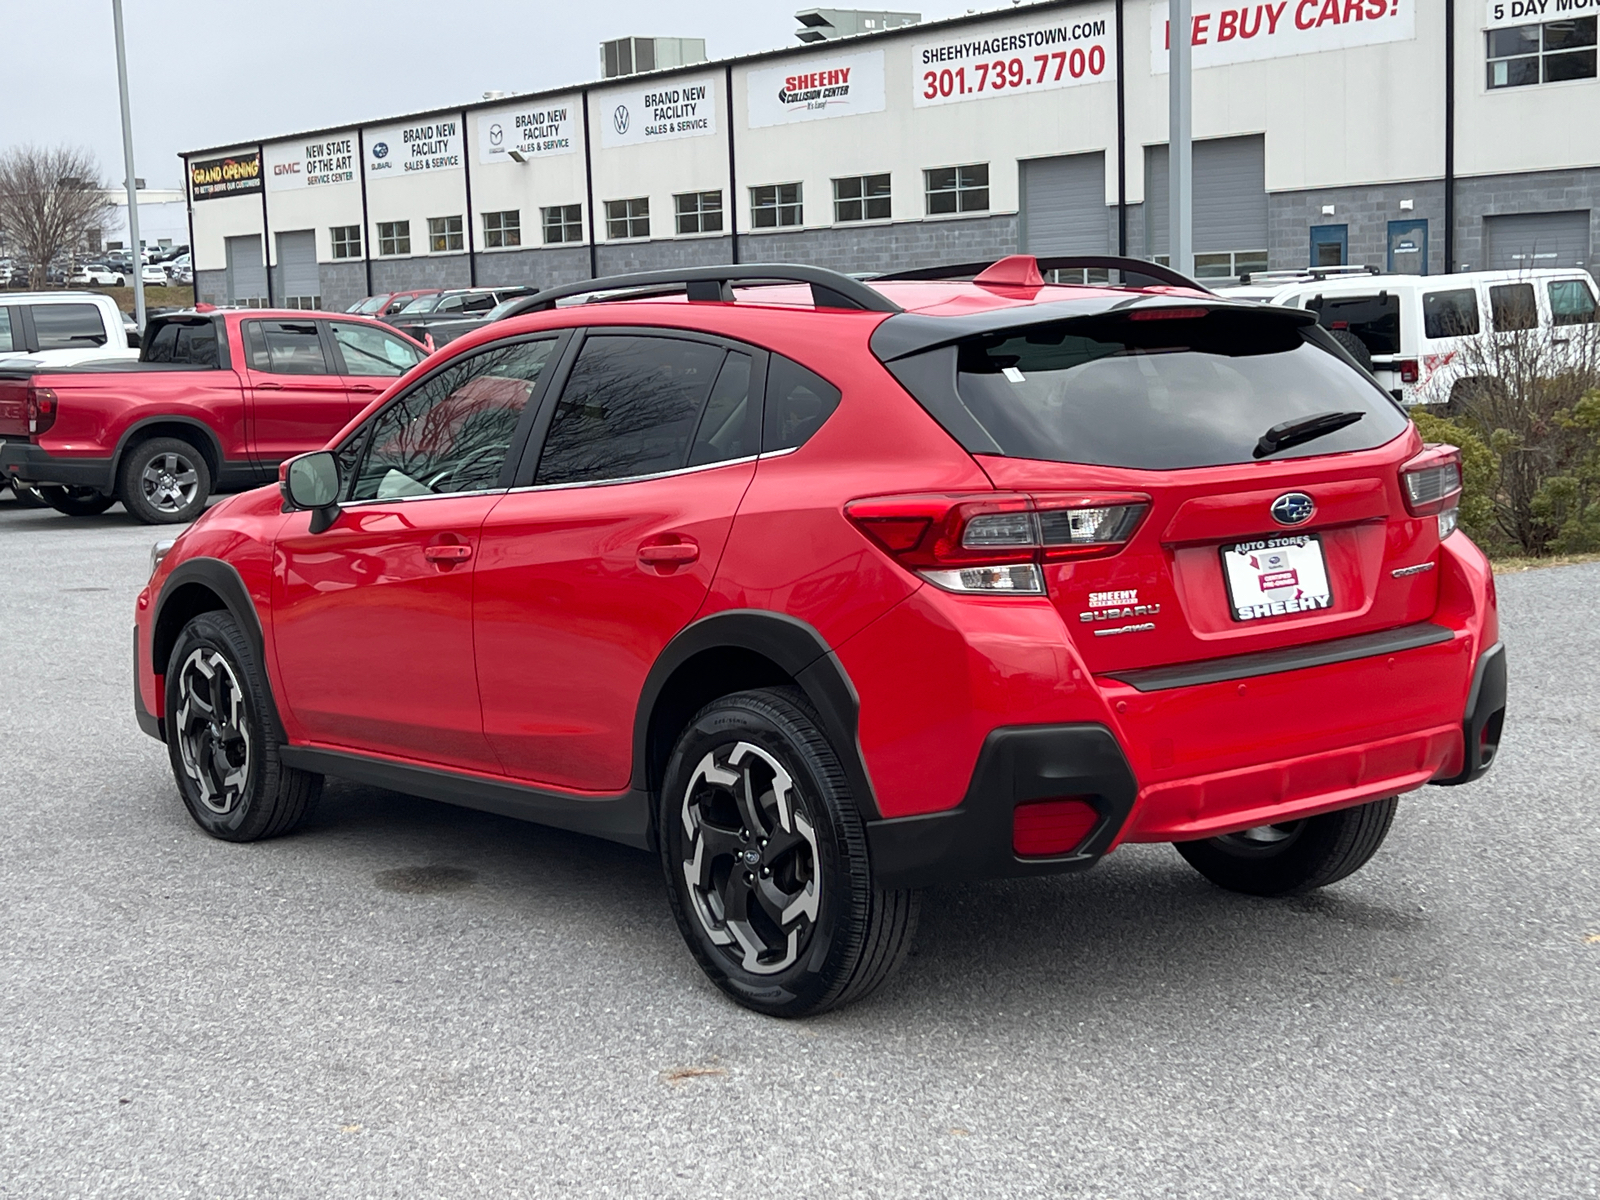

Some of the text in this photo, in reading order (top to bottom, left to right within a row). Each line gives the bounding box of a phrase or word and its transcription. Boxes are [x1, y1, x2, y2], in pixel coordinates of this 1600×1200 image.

[1494, 4, 1504, 20] 5
[1512, 0, 1548, 17] DAY
[1217, 1, 1286, 42] BUY
[1295, 0, 1398, 30] CARS!
[923, 20, 1105, 64] SHEEHYHAGERSTOWN.COM
[785, 67, 850, 92] SHEEHY
[923, 45, 1105, 99] 301.739.7700
[645, 86, 705, 107] BRAND NEW
[787, 85, 849, 103] COLLISION CENTER
[516, 109, 567, 128] BRAND NEW
[654, 103, 696, 121] FACILITY
[403, 123, 456, 143] BRAND NEW
[523, 124, 559, 140] FACILITY
[645, 118, 707, 136] SALES & SERVICE
[306, 140, 351, 159] NEW STATE
[412, 139, 448, 157] FACILITY
[537, 142, 541, 151] &
[543, 139, 569, 150] SERVICE
[194, 161, 258, 184] GRAND OPENING
[274, 162, 300, 175] GMC
[307, 156, 352, 174] OF THE ART
[371, 161, 392, 171] SUBARU
[404, 156, 458, 171] SALES & SERVICE
[308, 172, 353, 185] SERVICE CENTER
[1234, 536, 1310, 553] AUTO STORES
[1089, 589, 1137, 601] SHEEHY
[1080, 604, 1160, 622] SUBARU
[1238, 595, 1330, 620] SHEEHY
